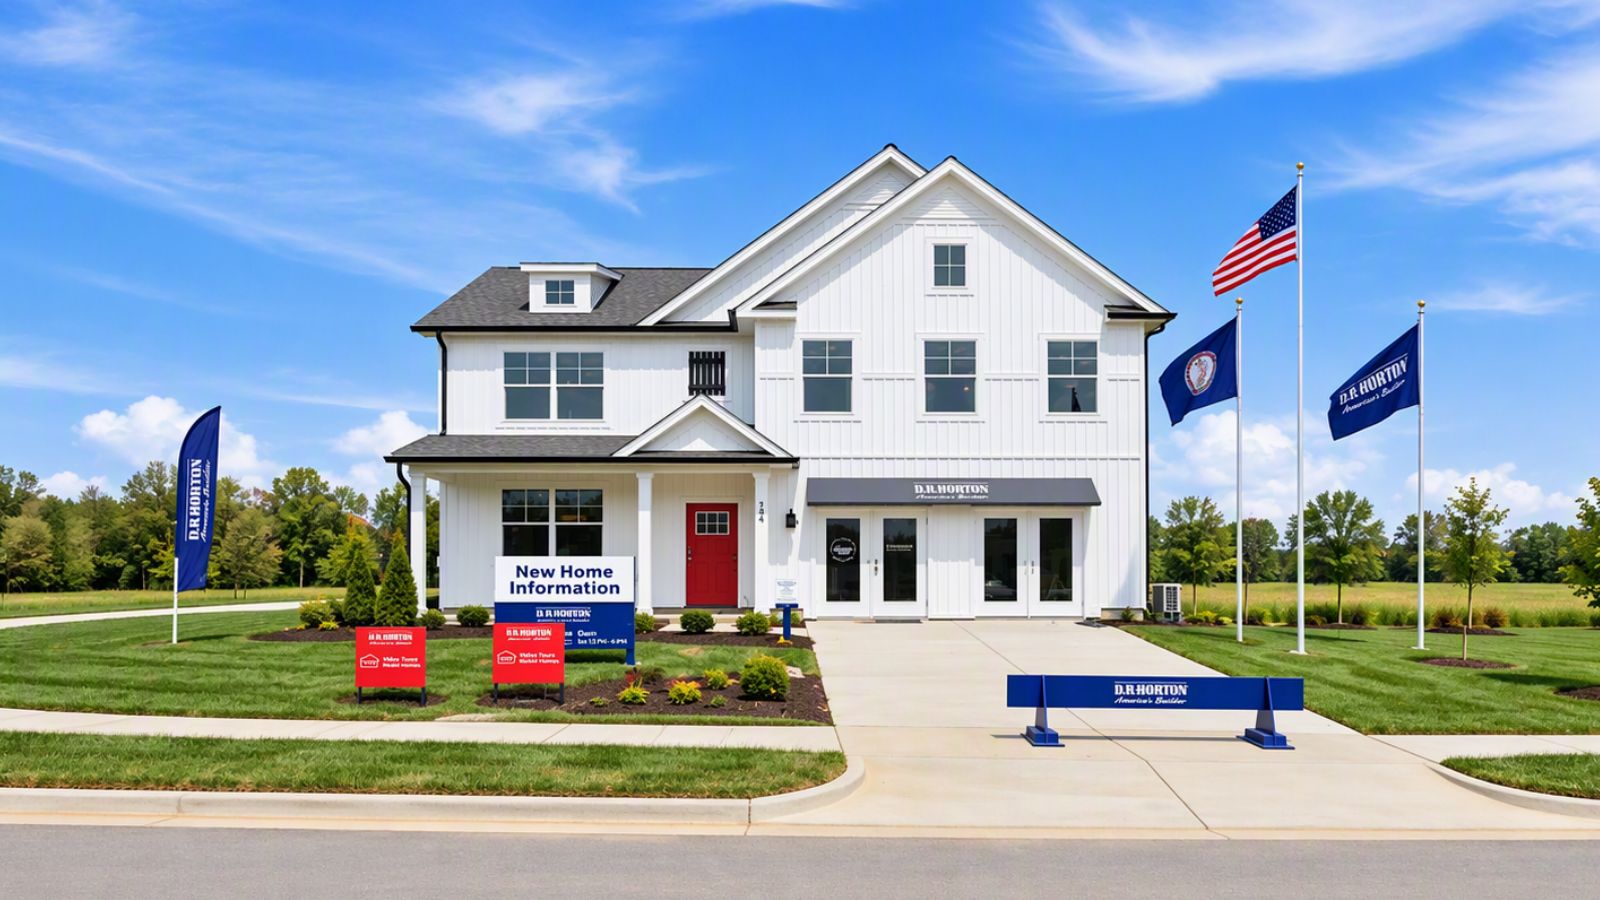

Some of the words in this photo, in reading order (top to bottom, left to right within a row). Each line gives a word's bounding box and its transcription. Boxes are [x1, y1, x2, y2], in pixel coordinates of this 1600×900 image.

[516, 565, 555, 578] New
[560, 565, 613, 578] Home
[510, 580, 620, 594] Information
[1114, 696, 1153, 704] America's
[1155, 696, 1187, 704] Builder
